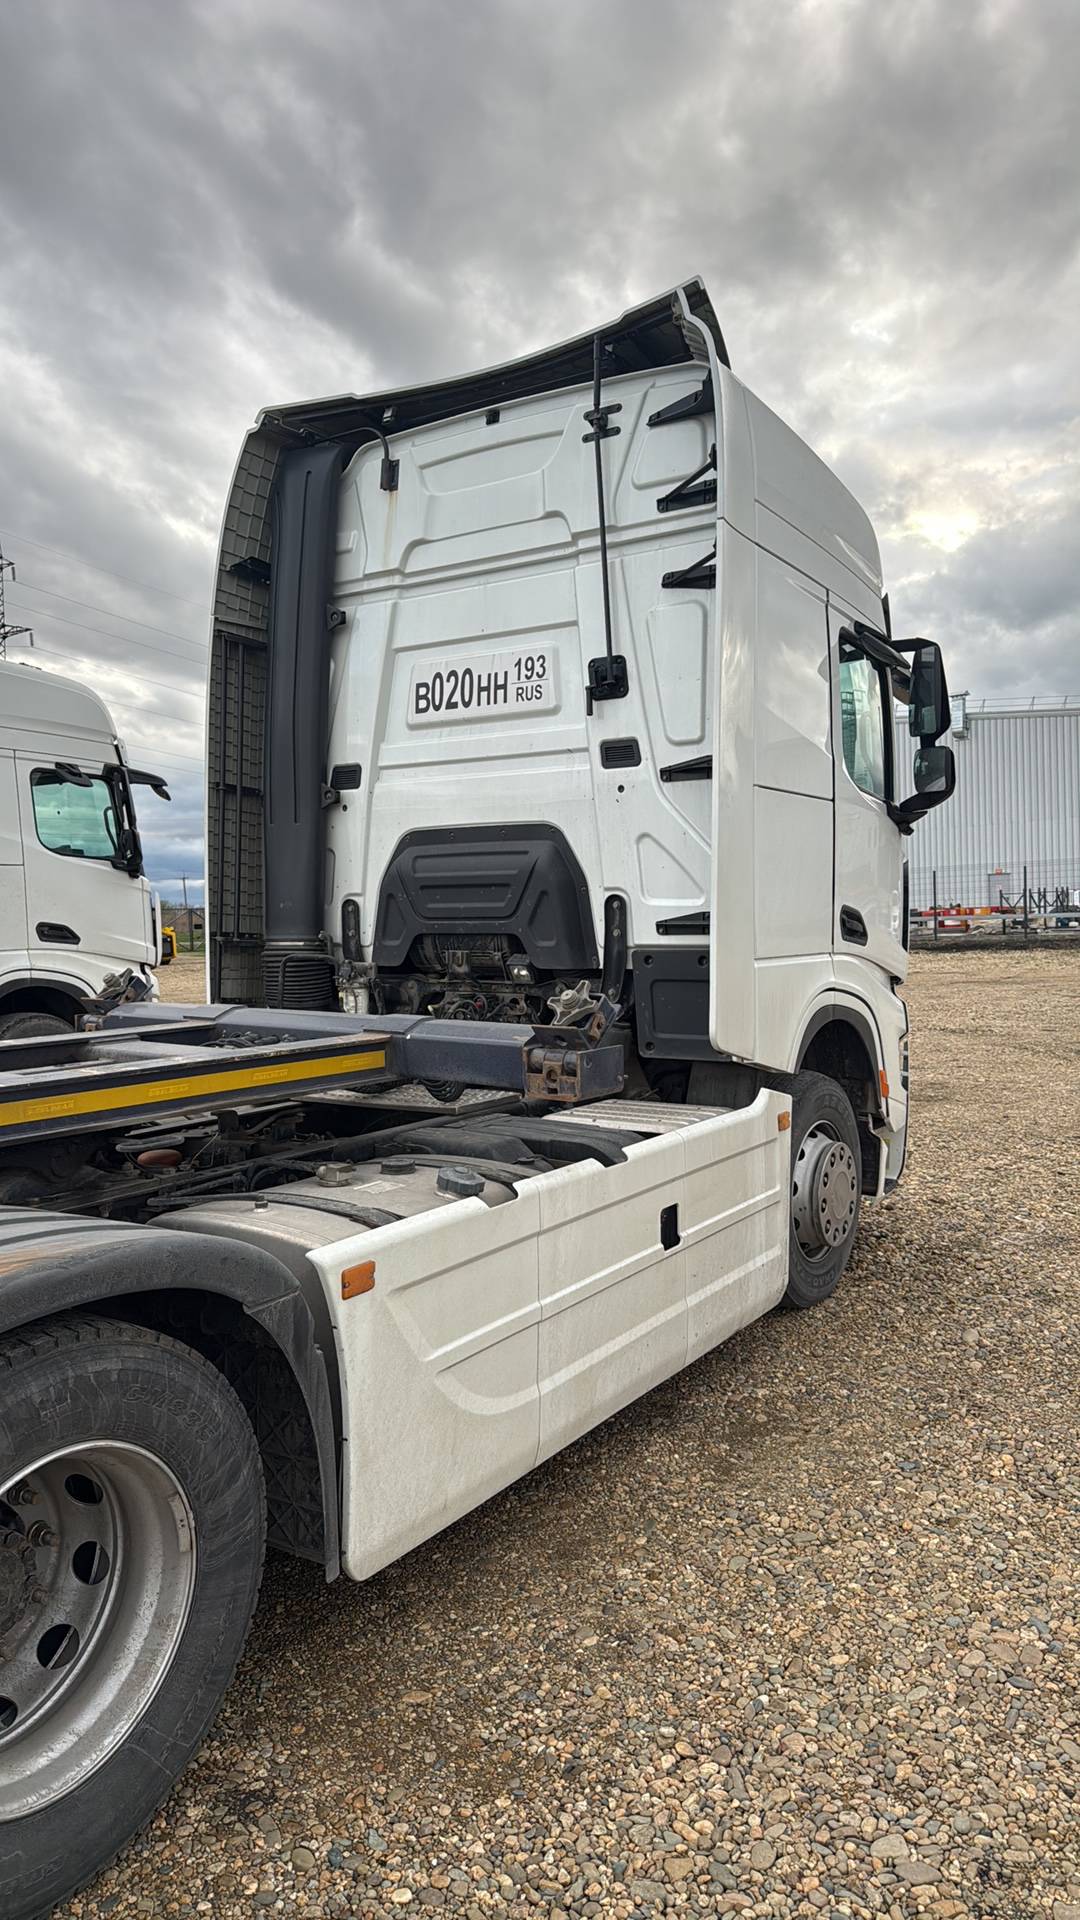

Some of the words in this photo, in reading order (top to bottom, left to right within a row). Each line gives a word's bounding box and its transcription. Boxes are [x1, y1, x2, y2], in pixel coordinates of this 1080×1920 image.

[415, 667, 508, 714] B020HH
[514, 654, 546, 681] 193
[515, 684, 543, 702] RUS
